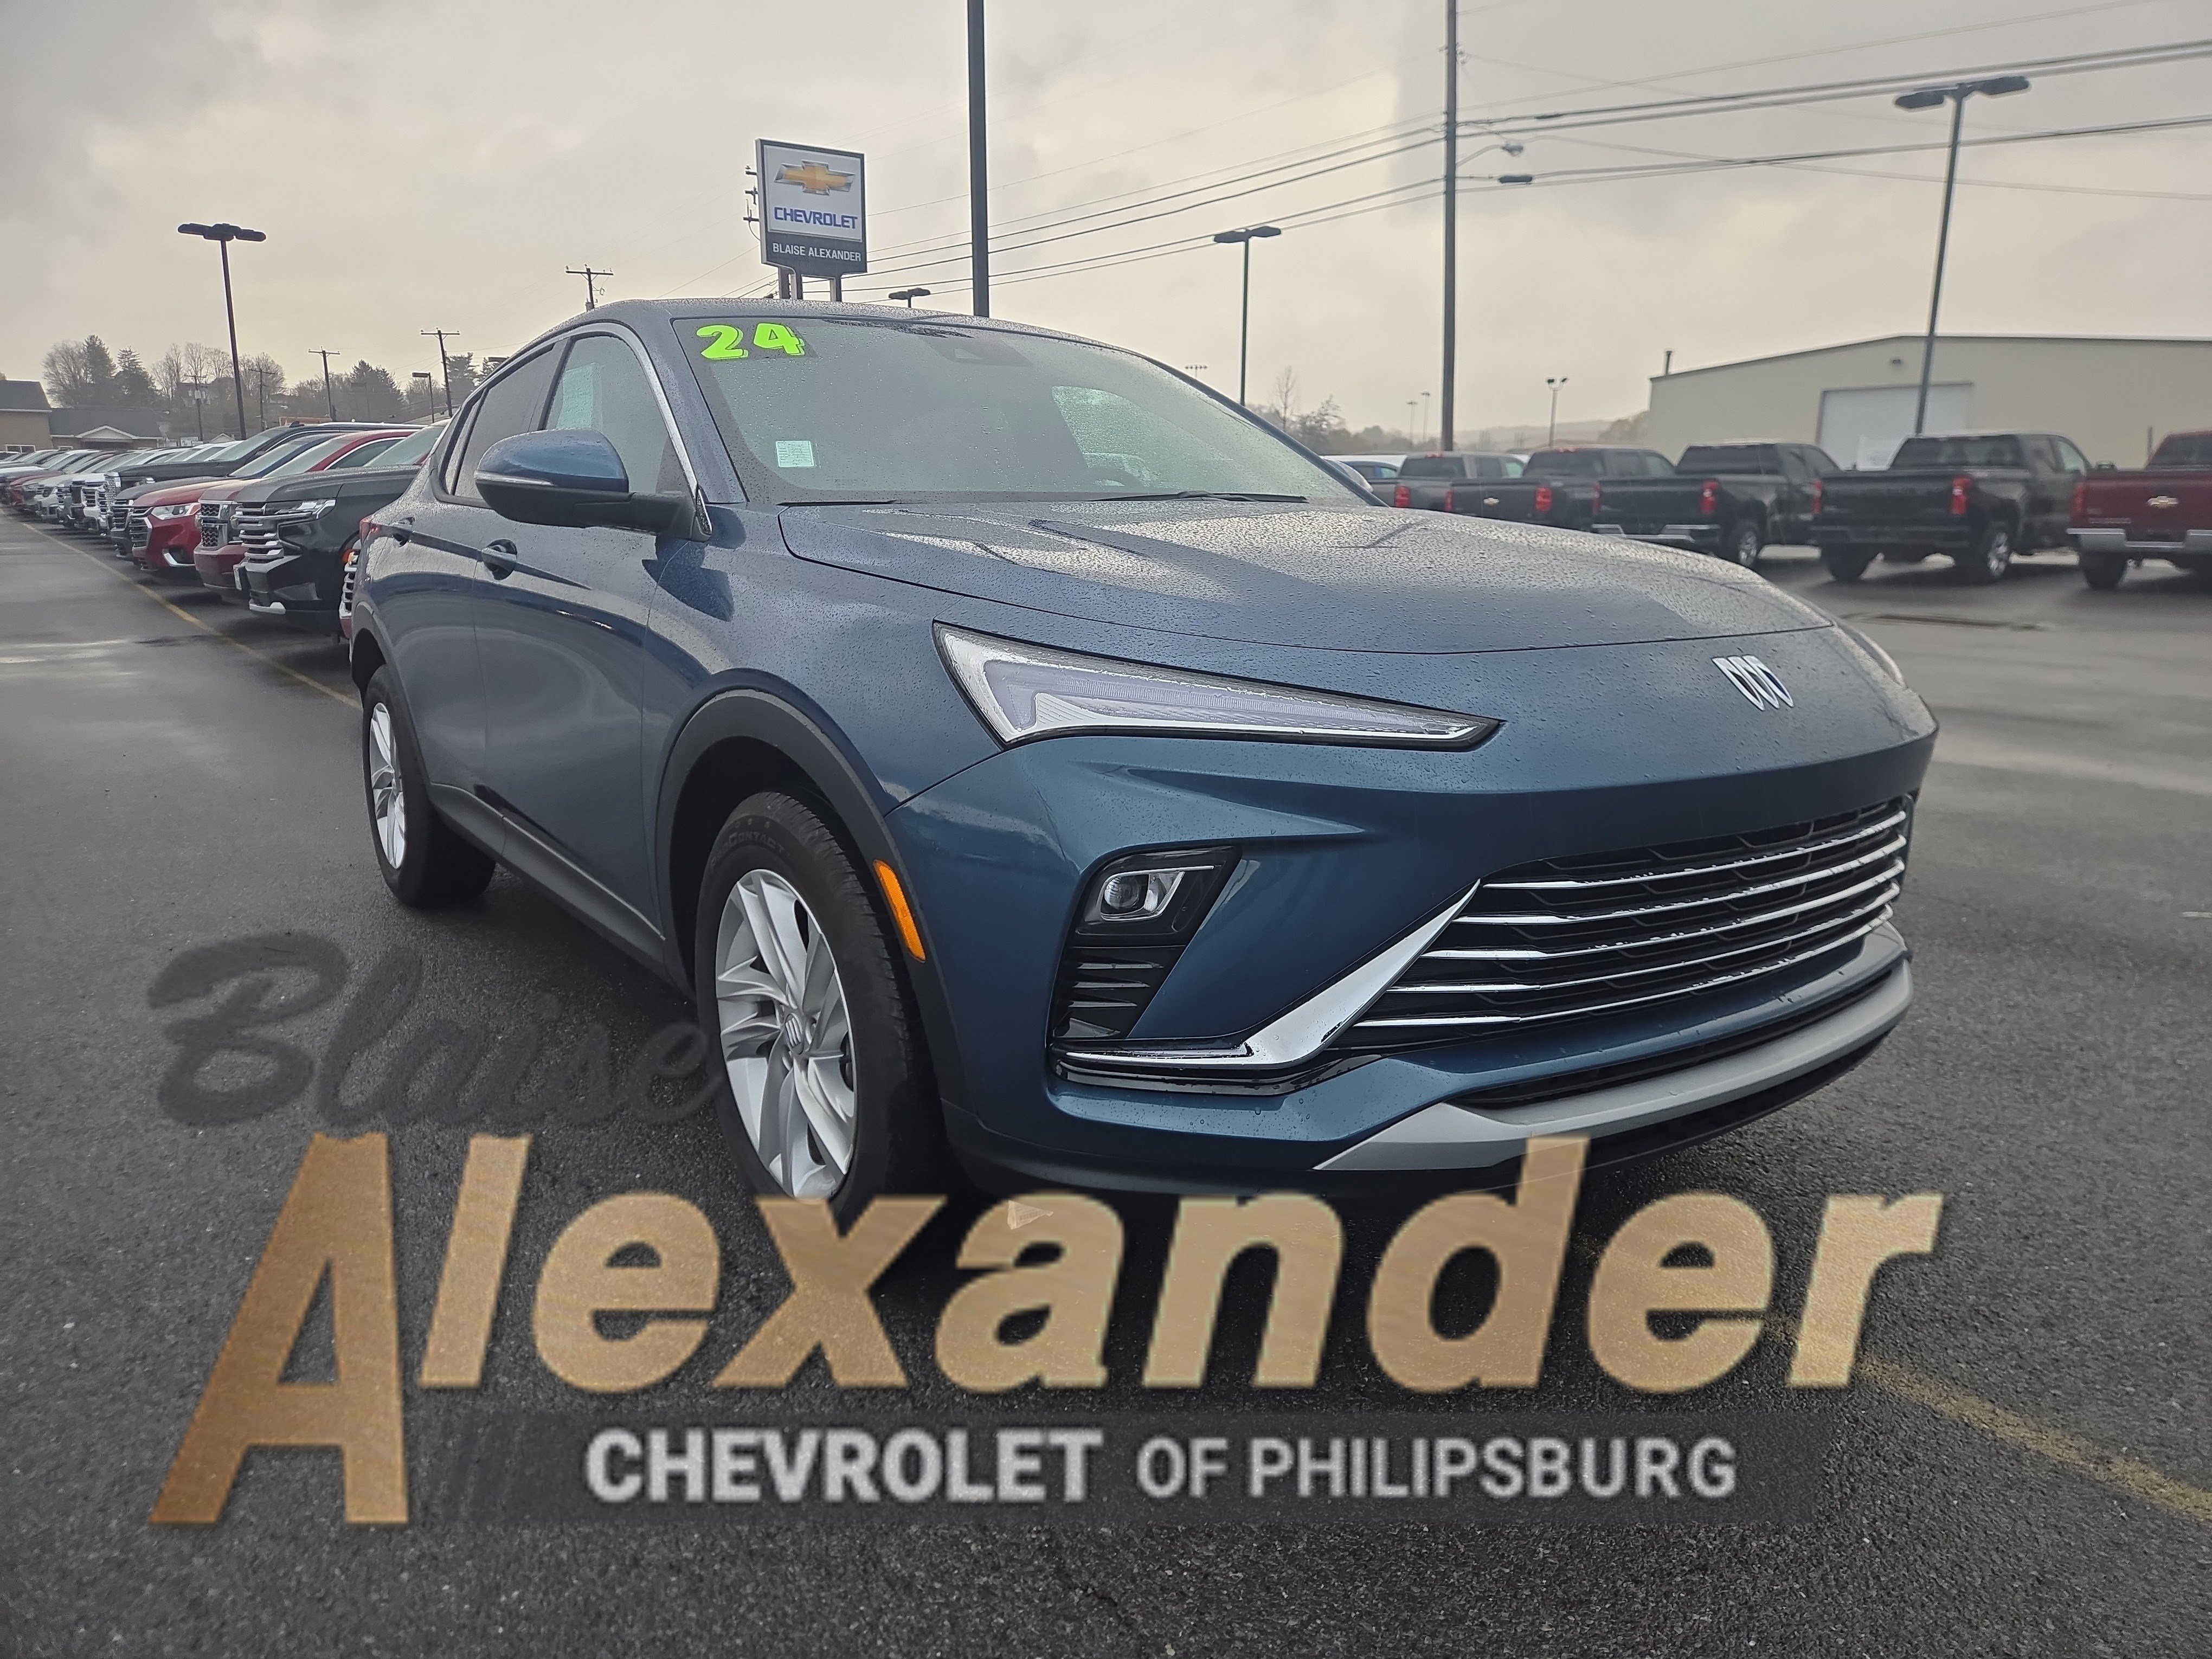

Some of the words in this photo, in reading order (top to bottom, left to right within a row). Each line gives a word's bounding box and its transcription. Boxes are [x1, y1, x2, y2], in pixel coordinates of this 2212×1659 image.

[774, 207, 858, 229] CHEVROLET
[772, 242, 806, 256] BLAISE
[808, 247, 861, 261] ALEXANDER
[696, 323, 805, 359] 24
